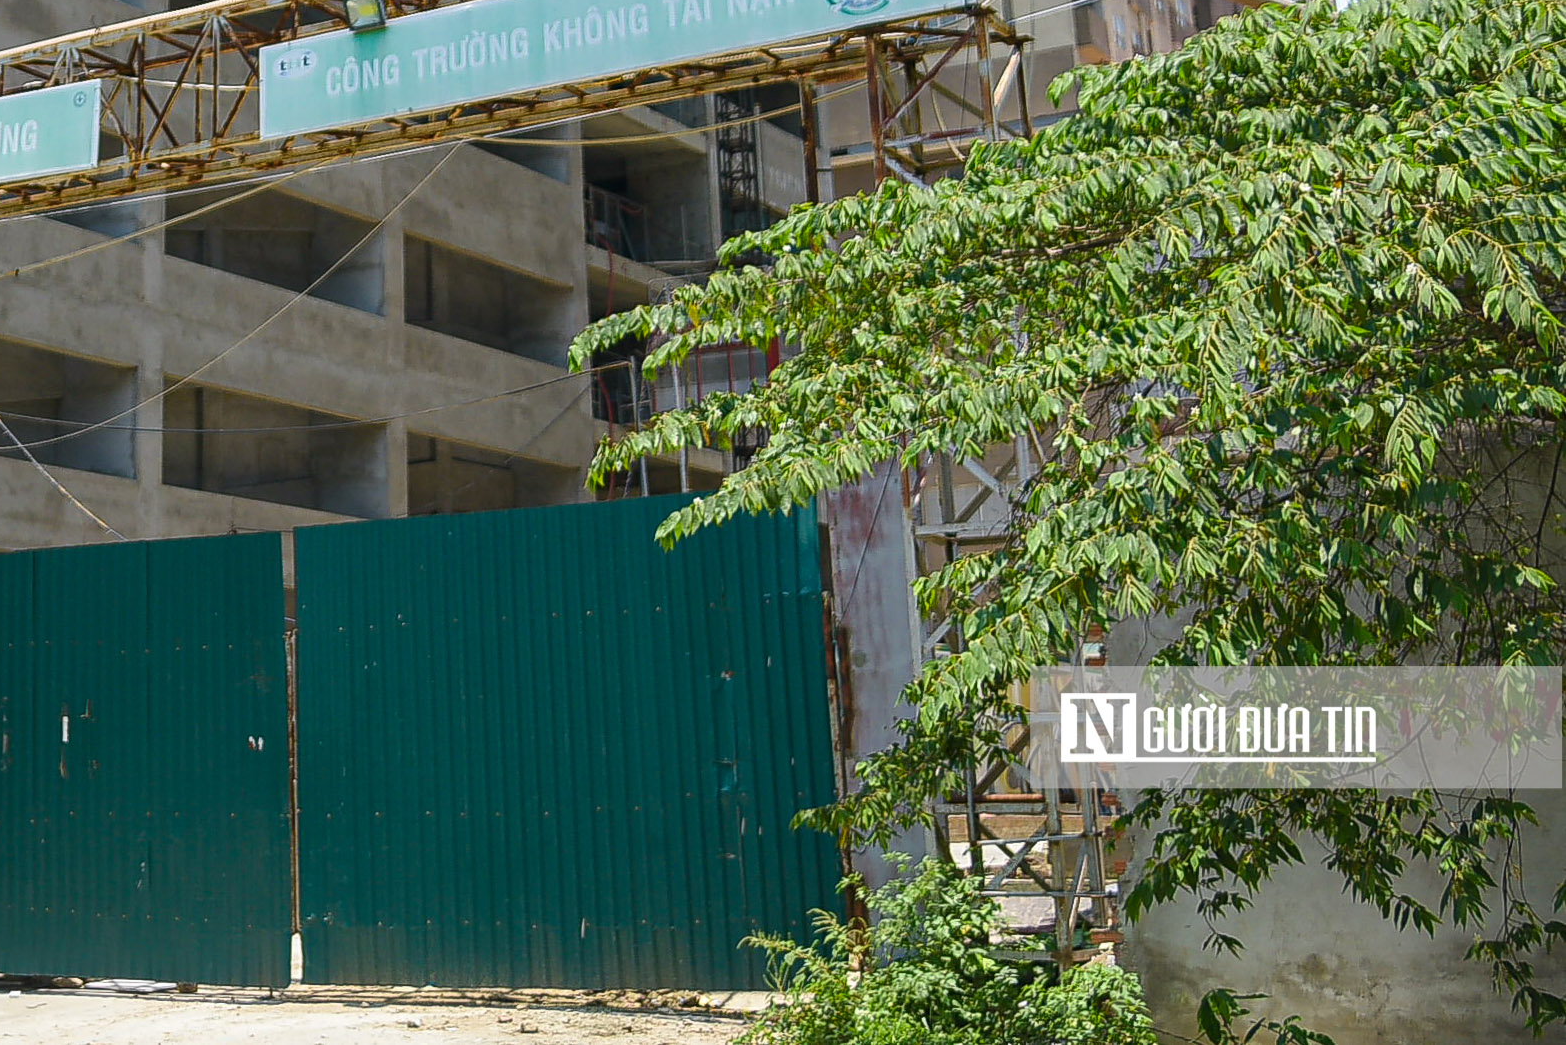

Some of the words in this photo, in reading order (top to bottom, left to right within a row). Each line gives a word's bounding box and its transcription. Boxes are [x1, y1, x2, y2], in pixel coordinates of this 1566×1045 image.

[326, 55, 401, 98] CÔNG
[411, 25, 529, 79] TRƯỜNG
[542, 2, 649, 51] KHÔNG
